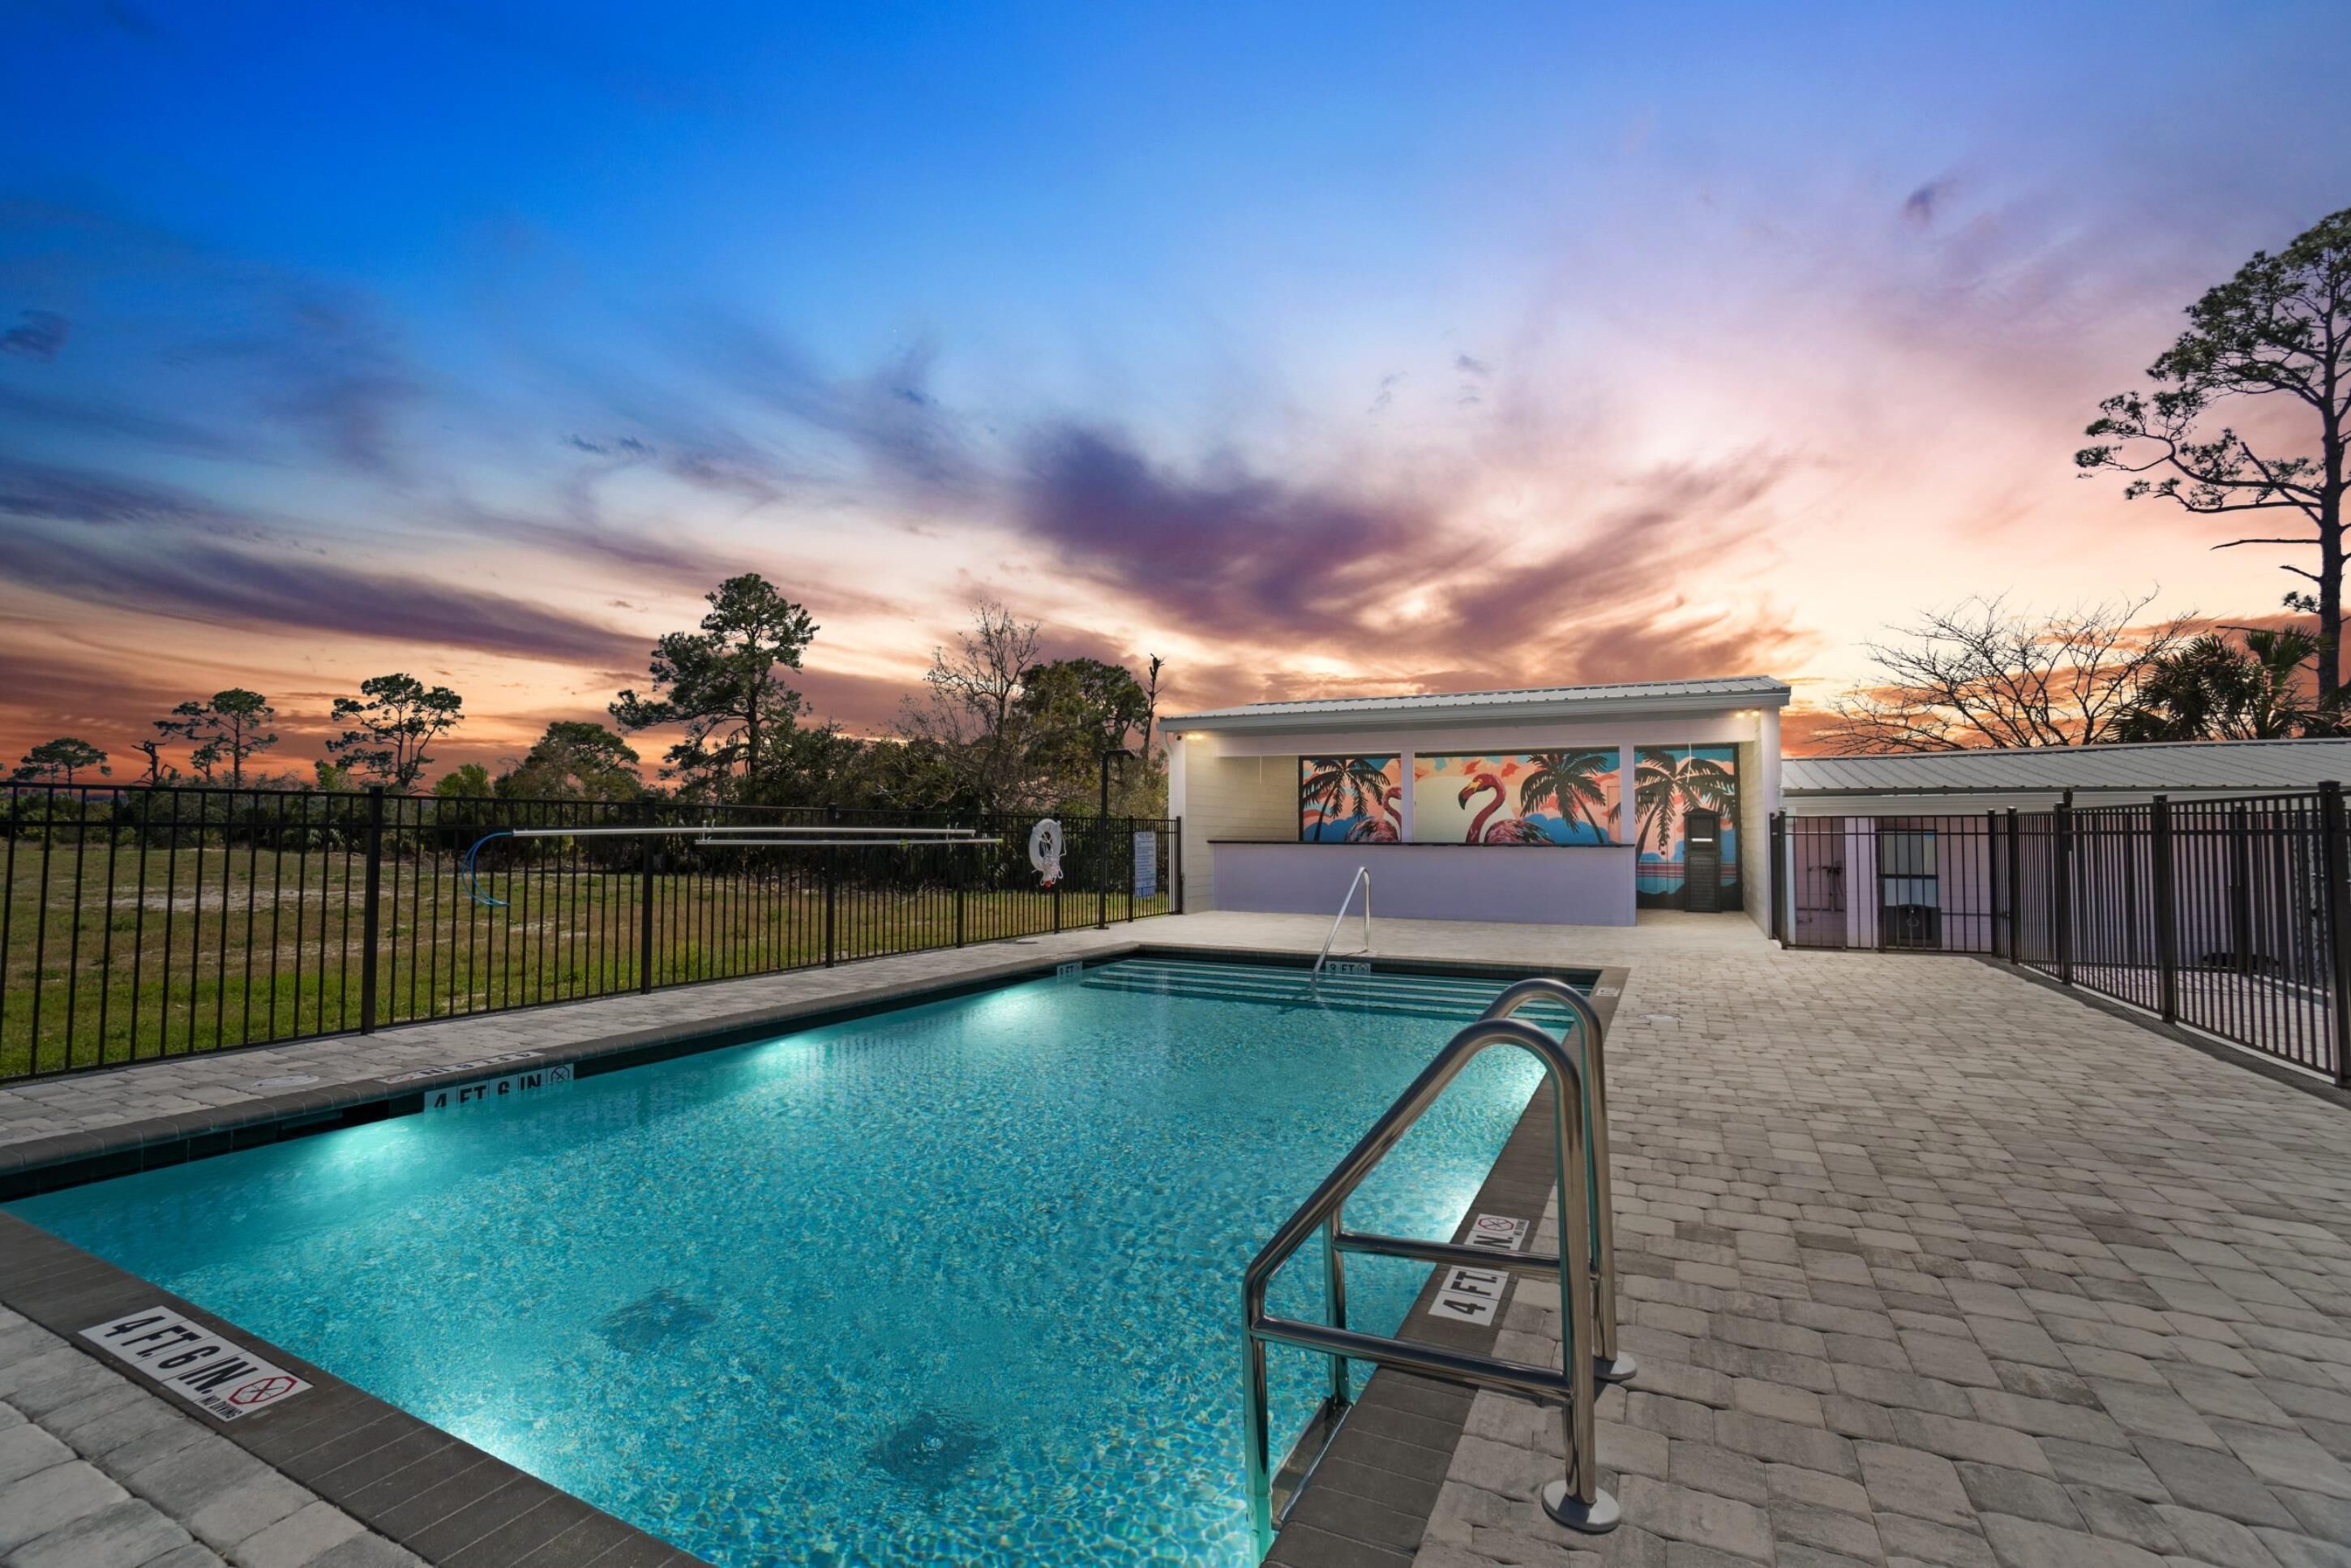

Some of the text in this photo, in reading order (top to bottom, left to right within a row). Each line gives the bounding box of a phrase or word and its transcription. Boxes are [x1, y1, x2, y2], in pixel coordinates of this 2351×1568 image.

[435, 1092, 447, 1107] 4
[460, 1085, 486, 1103] FT
[520, 1073, 542, 1090] IN
[1443, 1235, 1514, 1315] 4 FT. N.
[104, 1315, 259, 1394] 4 FT. 6 IN.
[199, 1395, 243, 1419] NO DIVING
